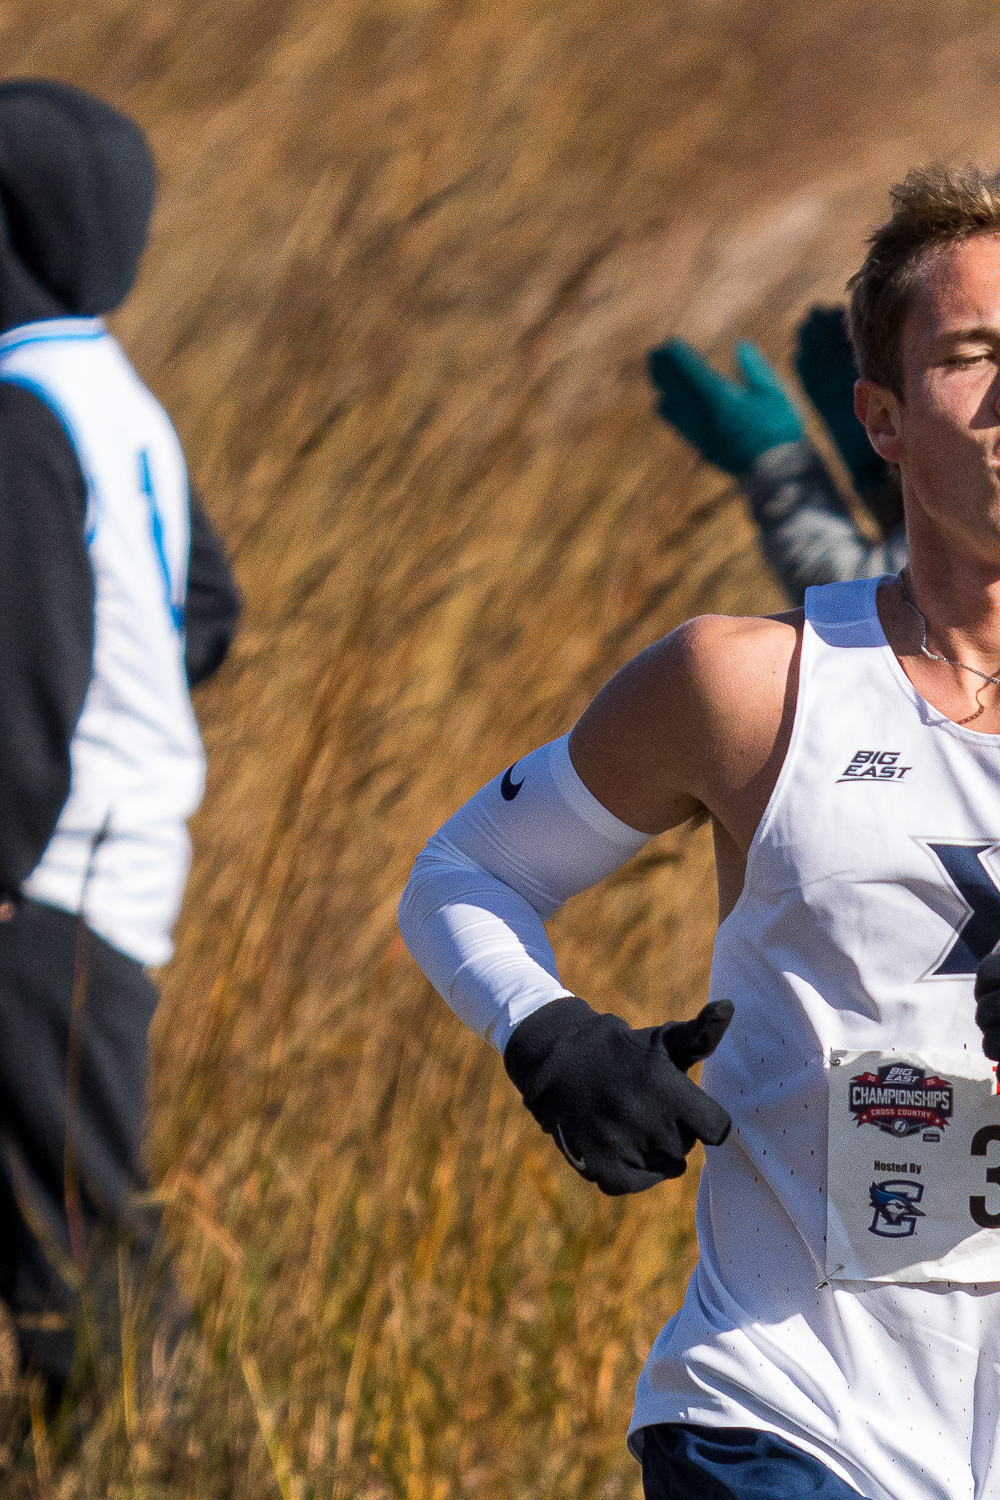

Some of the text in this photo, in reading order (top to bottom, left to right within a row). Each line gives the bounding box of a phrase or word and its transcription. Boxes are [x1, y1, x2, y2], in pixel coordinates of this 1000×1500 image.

[850, 750, 902, 766] BIG
[841, 765, 913, 780] EAST
[889, 1067, 914, 1076] BIG
[885, 1075, 919, 1083] EAST
[852, 1086, 950, 1110] CHAMPIONSHIPS
[870, 1108, 931, 1118] CROSS COUNTRY
[874, 1160, 921, 1174] Hosted By
